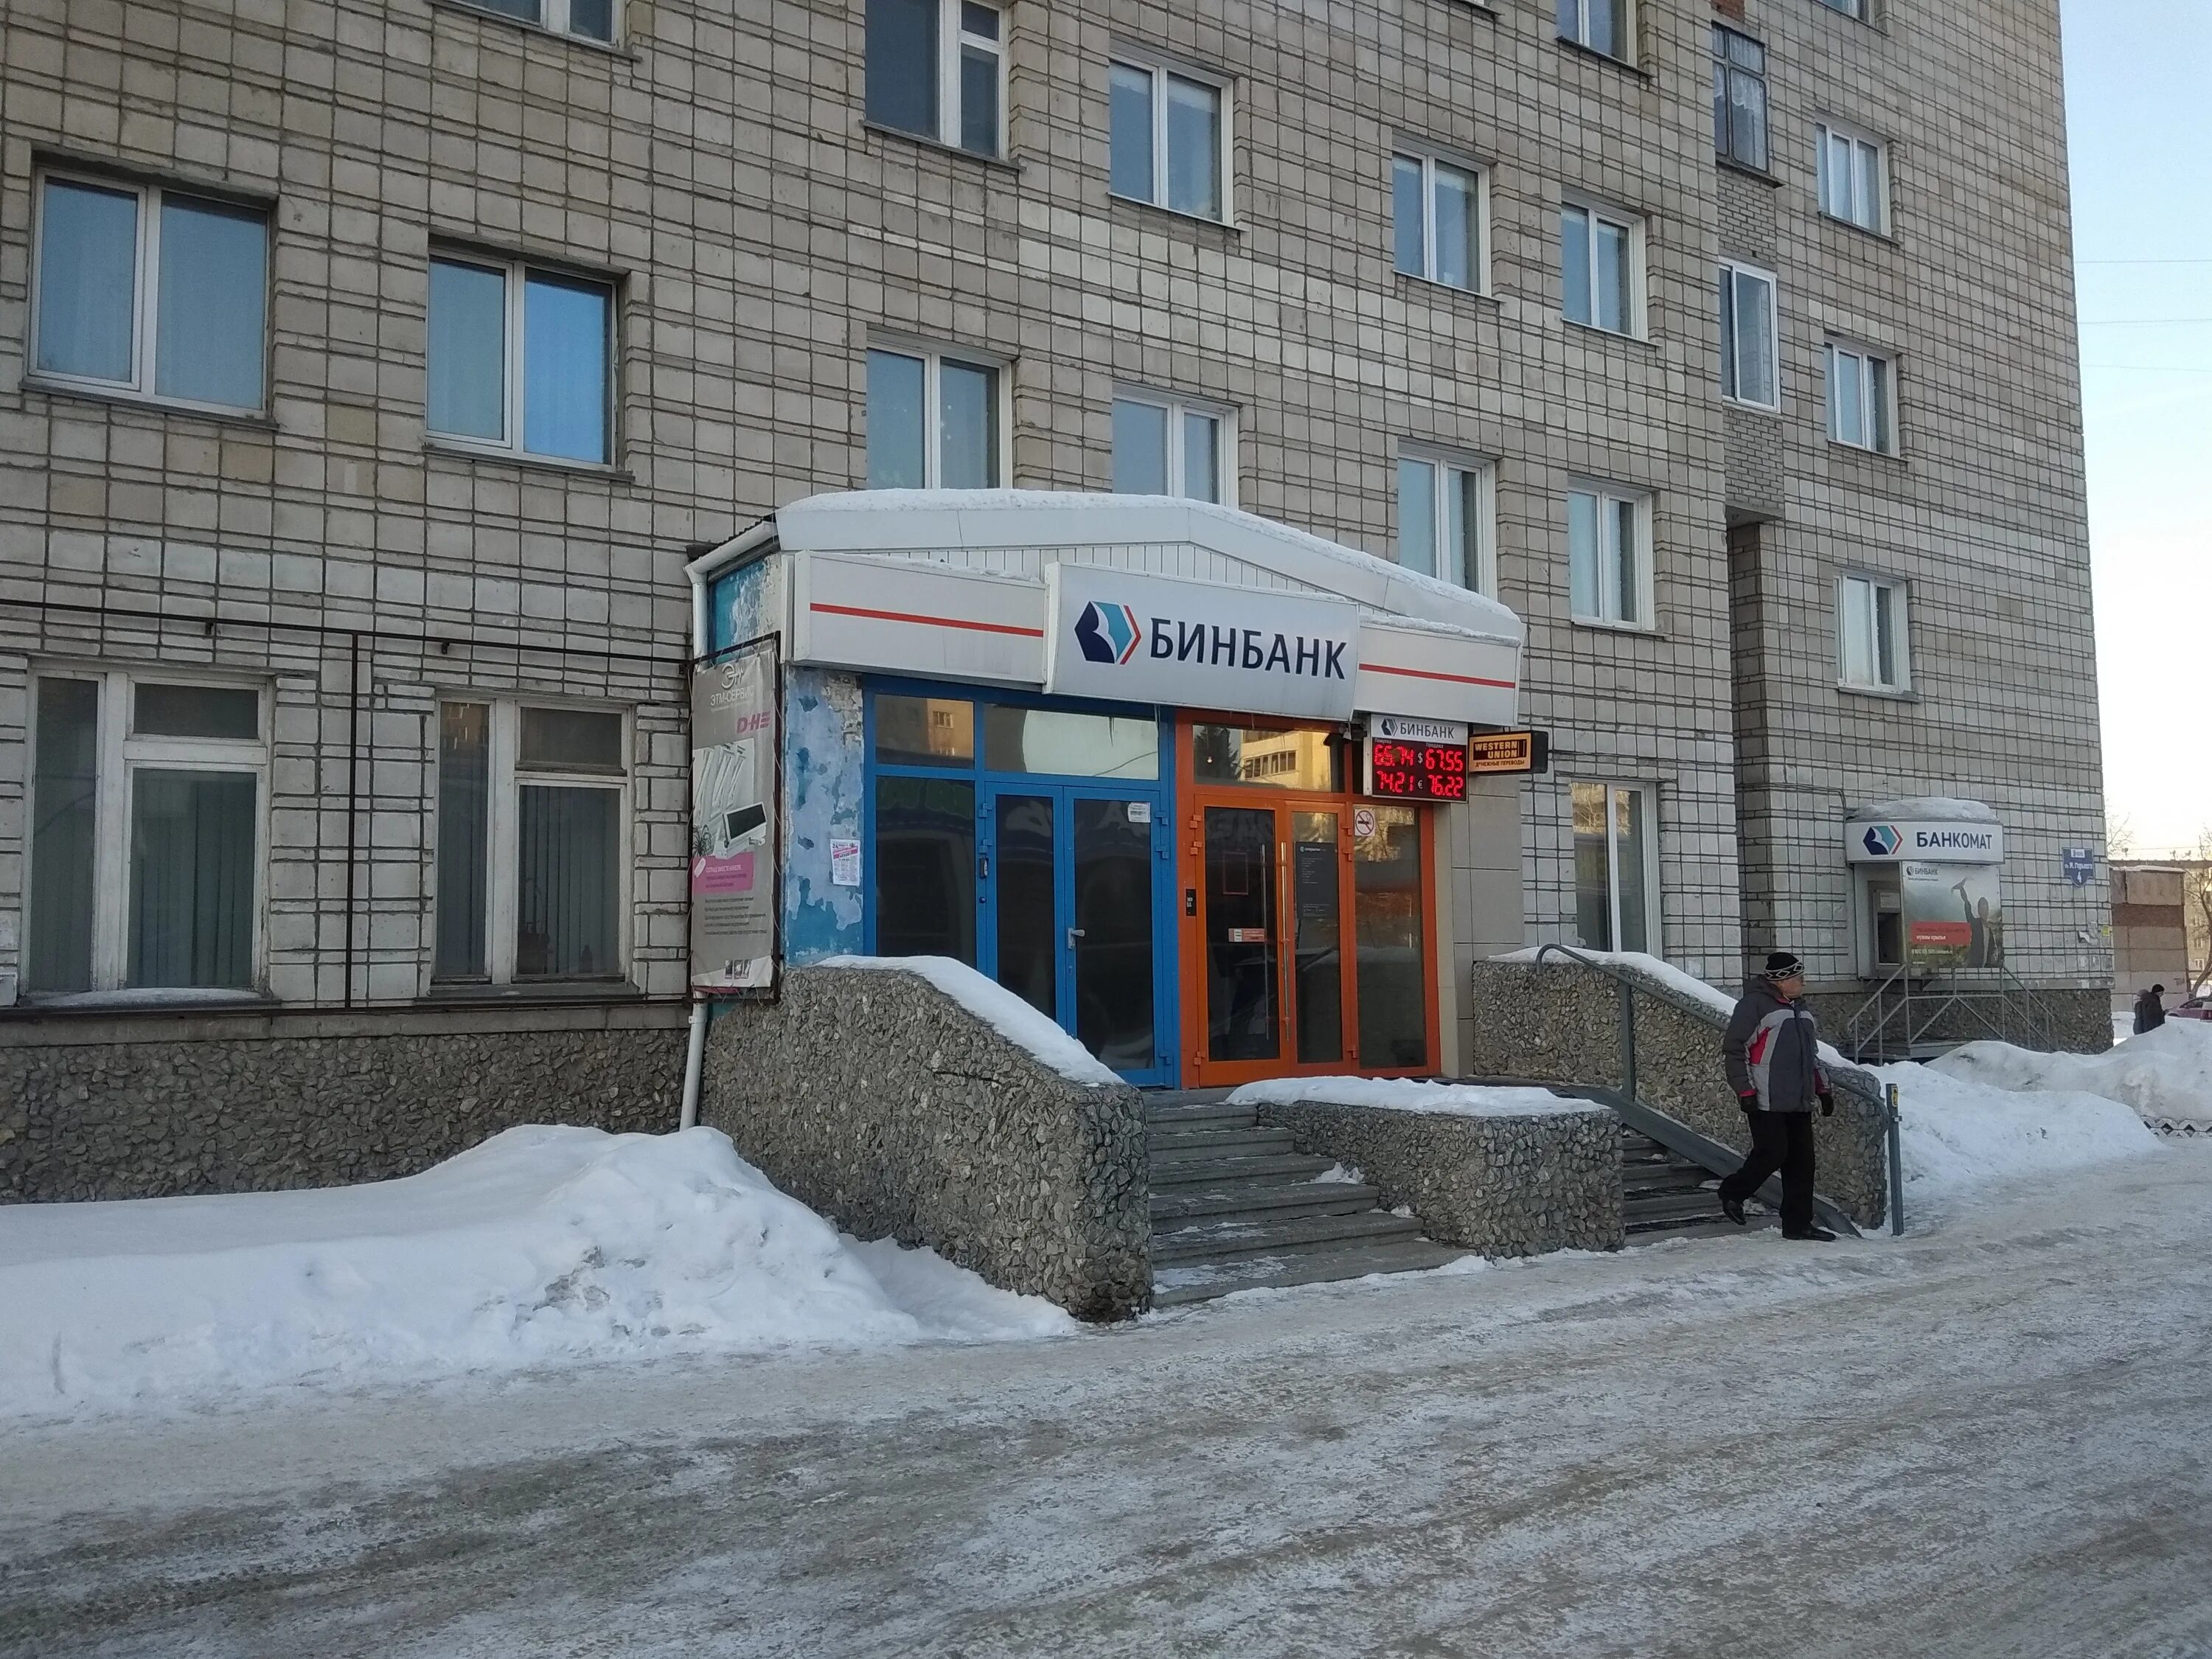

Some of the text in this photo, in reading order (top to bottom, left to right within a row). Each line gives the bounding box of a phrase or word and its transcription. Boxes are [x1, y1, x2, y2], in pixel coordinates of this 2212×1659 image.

[1150, 616, 1348, 681] БИНБАНК
[1400, 722, 1455, 739] БИНБАНК
[1475, 740, 1517, 751] WESTERN
[1487, 749, 1517, 759] UNION
[1417, 752, 1424, 764] $
[1425, 748, 1464, 772] 67.55
[1417, 779, 1424, 790] €
[1427, 775, 1464, 797] 76.22
[1916, 832, 1993, 850] БАНКОМАТ
[1914, 867, 1938, 875] БИНБАНК
[2077, 871, 2082, 883] 4
